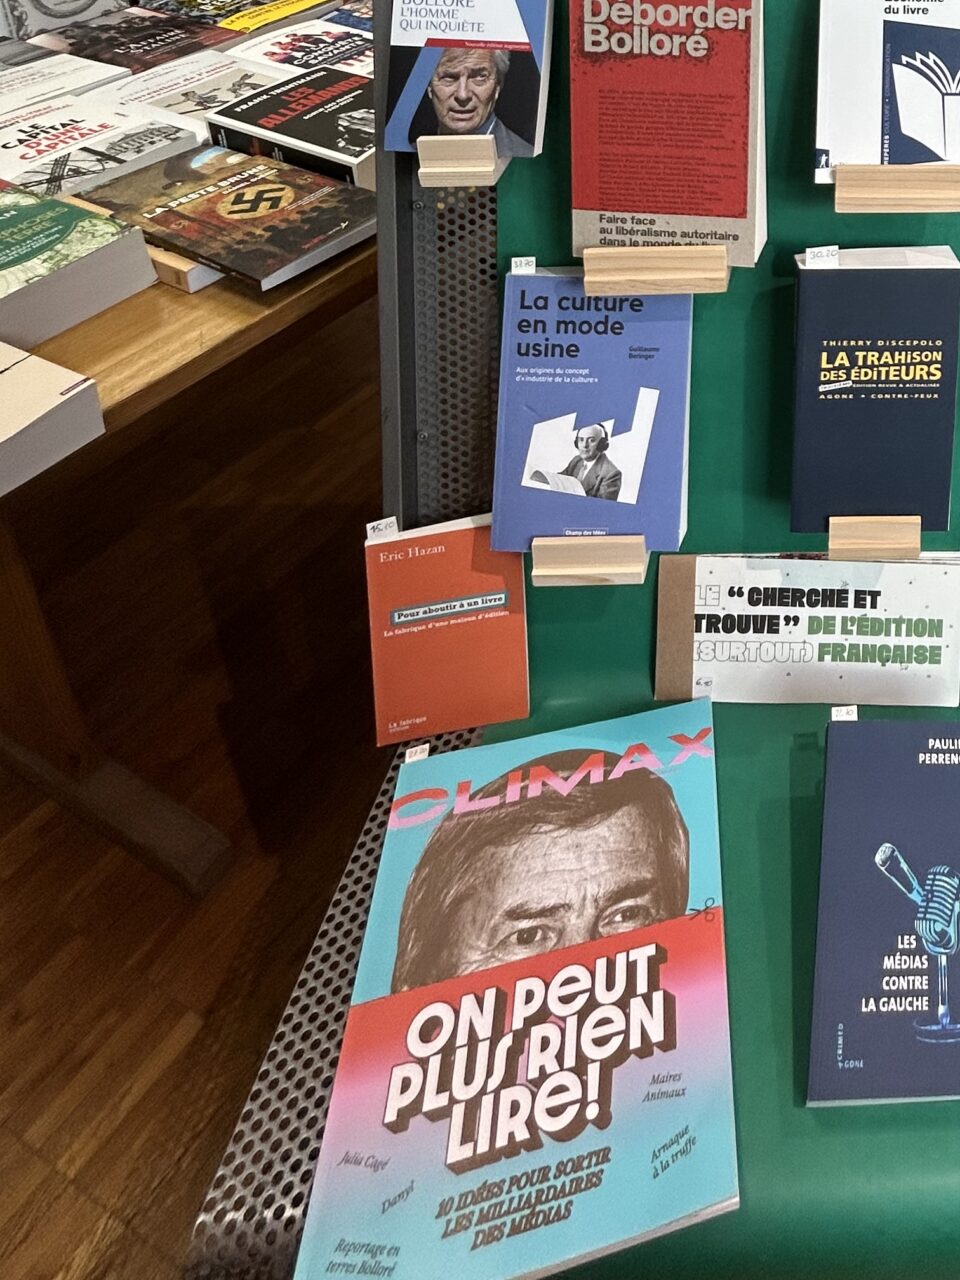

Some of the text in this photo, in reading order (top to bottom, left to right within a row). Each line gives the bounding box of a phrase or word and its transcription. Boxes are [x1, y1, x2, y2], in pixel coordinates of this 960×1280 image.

[400, 7, 459, 20] L'HOMME
[884, 4, 929, 15] du livre
[399, 19, 484, 33] QUI INQUIÈTE
[583, 23, 709, 58] Bolloré
[257, 75, 371, 129] ALLEMANDS
[281, 86, 317, 101] LES
[1, 118, 87, 150] CAPITAL
[17, 123, 44, 135] LE
[23, 124, 88, 150] D'UNE
[19, 122, 114, 161] CAPITALE
[143, 164, 270, 219] LA PESTE BRUNE
[599, 213, 656, 226] Faire face
[599, 225, 740, 242] au libéralisme autoritaire
[518, 289, 644, 313] La culture
[517, 315, 625, 336] en mode
[516, 337, 581, 358] usine
[820, 351, 850, 368] LA
[820, 370, 847, 381] DES
[379, 544, 446, 563] Eric Hazan
[396, 610, 421, 621] Pour
[422, 603, 457, 616] aboutir
[467, 600, 479, 608] un
[481, 596, 503, 605] livre
[695, 585, 721, 606] LE
[854, 589, 881, 610] ET
[807, 615, 835, 636] DE
[840, 613, 943, 638] L'ÉDITION
[817, 642, 942, 667] FRANÇAISE
[387, 726, 713, 830] CLIMAX
[898, 934, 917, 949] LES
[883, 952, 928, 970] MÉDIAS
[882, 975, 929, 990] CONTRE
[862, 997, 929, 1012] LA GAUCHE
[406, 986, 497, 1059] ON
[383, 1030, 521, 1125] PLUS
[642, 1085, 687, 1103] Animaux
[651, 1124, 690, 1164] Arnaque
[435, 1146, 613, 1219] 10 IDÉES POUR SORTIR
[441, 1170, 605, 1240] LES MILLIARDAIRES
[470, 1200, 575, 1251] DES MÉDIAS
